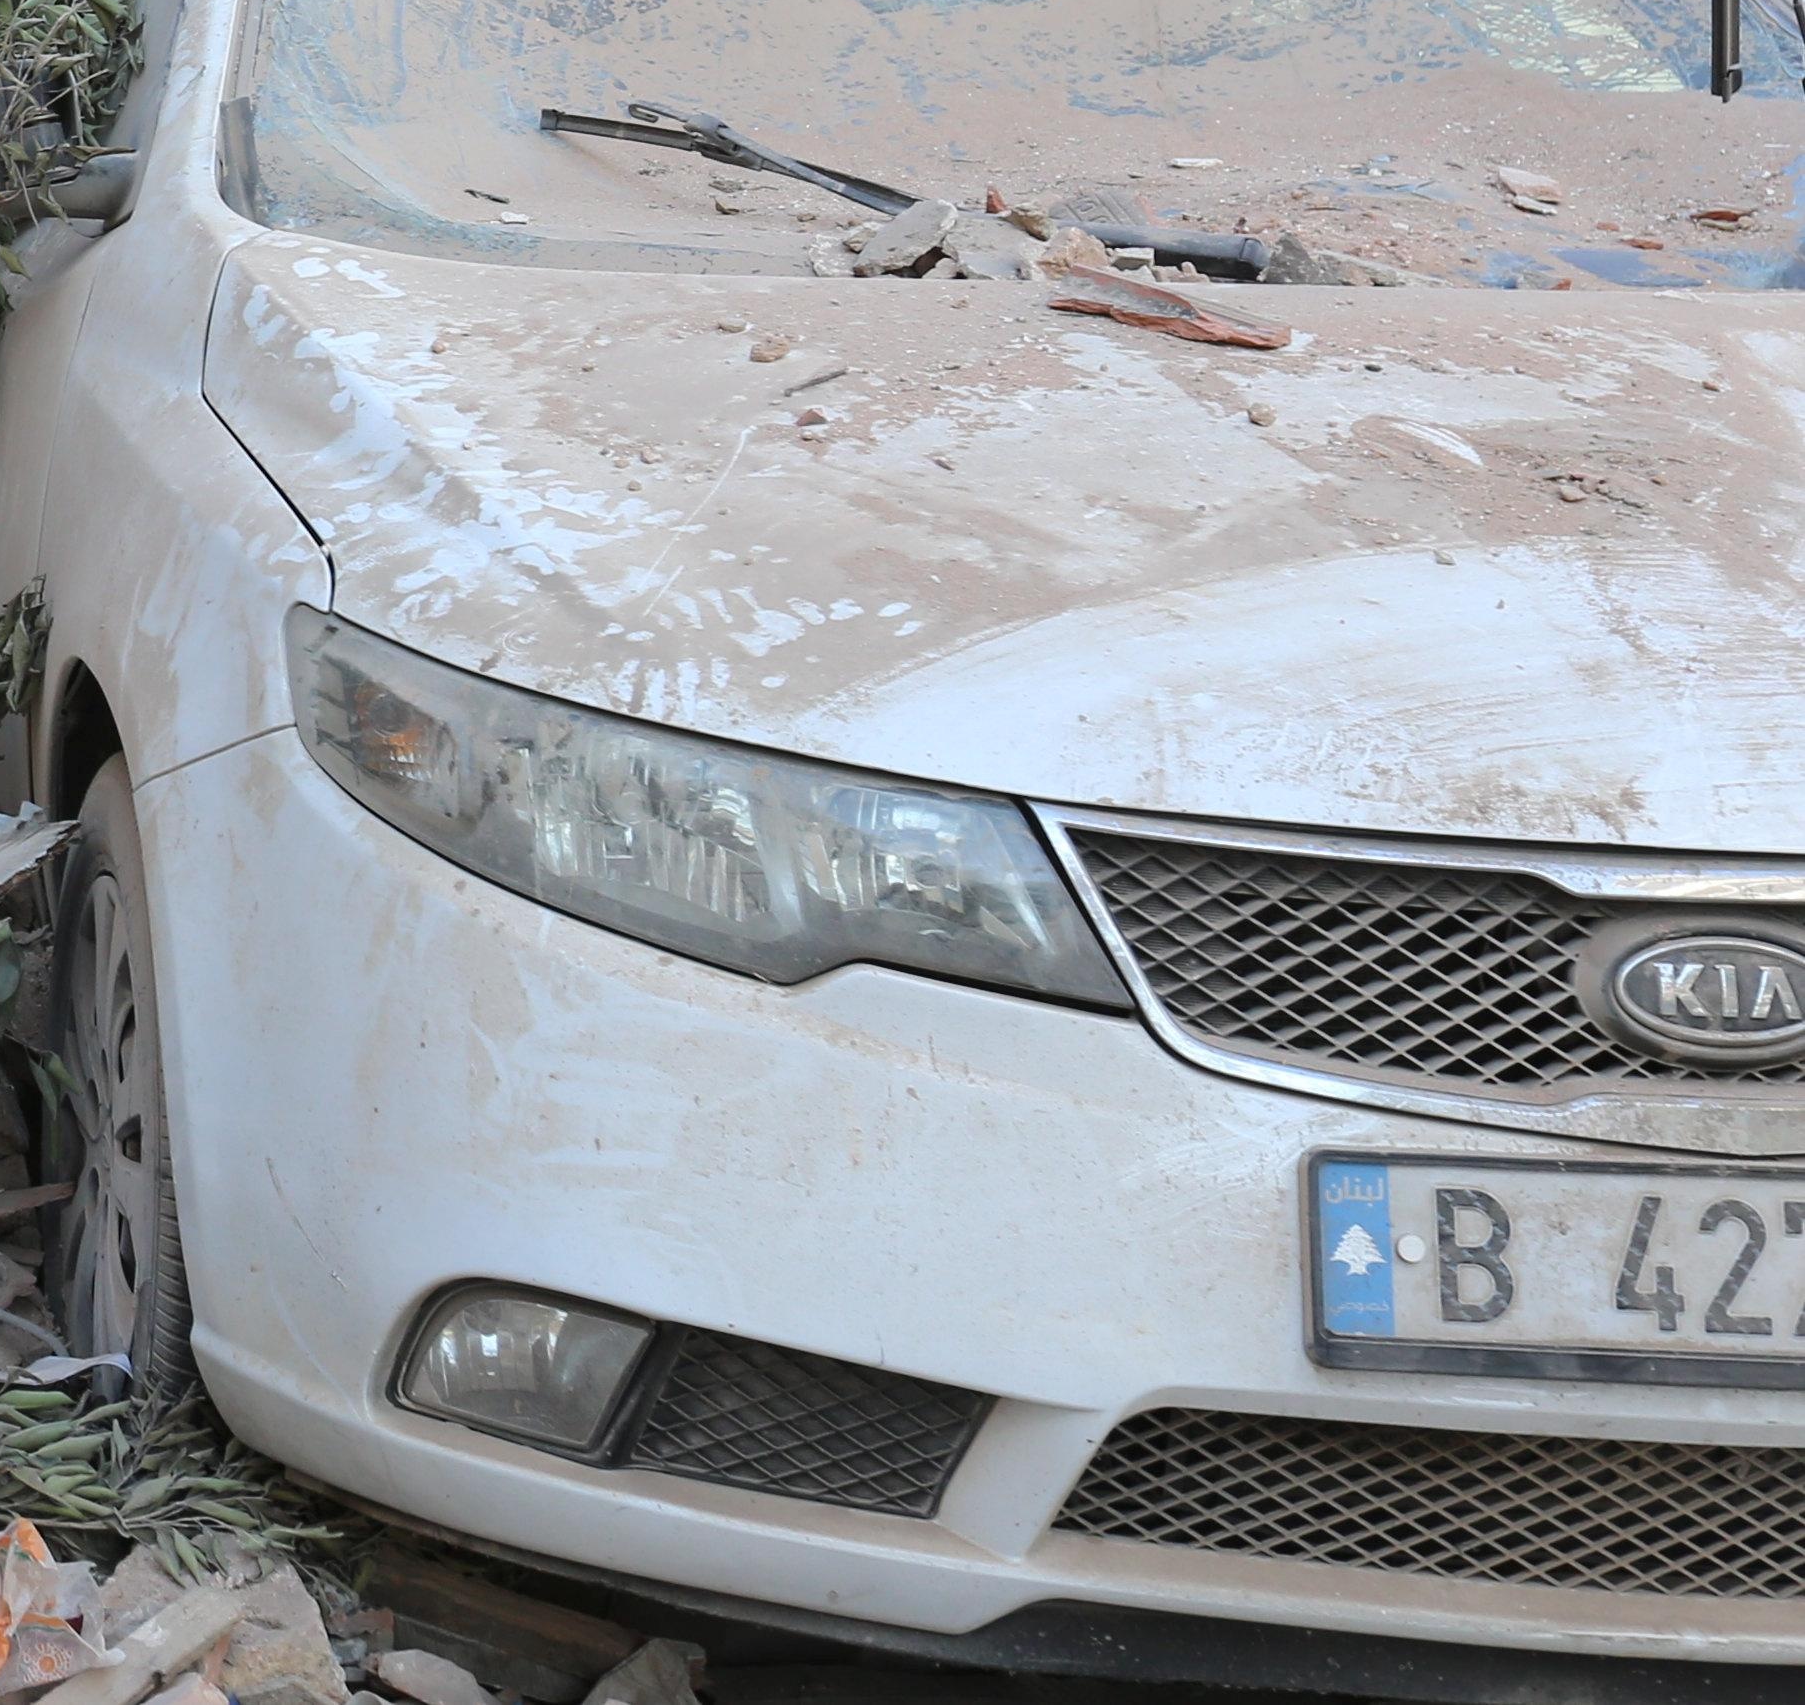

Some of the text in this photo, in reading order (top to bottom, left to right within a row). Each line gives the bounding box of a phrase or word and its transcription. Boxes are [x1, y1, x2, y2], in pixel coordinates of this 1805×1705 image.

[1652, 962, 1803, 1020] KIA
[1325, 1176, 1384, 1208] لبنان
[1435, 1187, 1514, 1323] B
